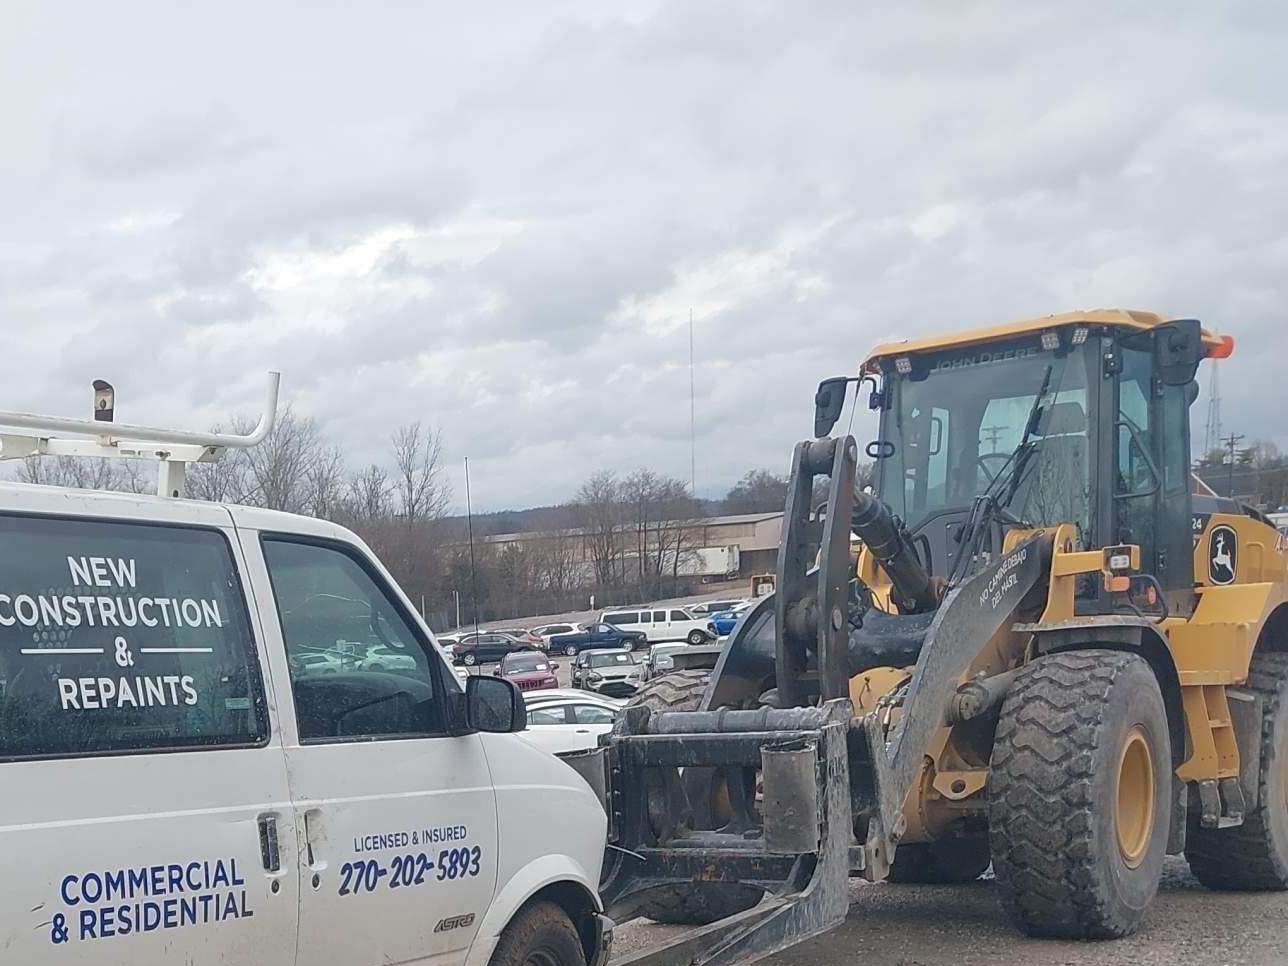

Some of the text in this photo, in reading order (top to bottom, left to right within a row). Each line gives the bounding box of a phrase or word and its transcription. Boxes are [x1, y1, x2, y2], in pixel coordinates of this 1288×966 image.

[67, 556, 136, 588] NEW
[114, 636, 134, 667] &
[58, 675, 198, 710] REPAINTS
[354, 825, 467, 852] LICENSED & INSURED
[61, 857, 244, 906] COMMERCIAL
[338, 845, 481, 896] 270-202-5893
[51, 890, 254, 944] & RESIDENTIAL
[433, 912, 476, 933] ASTRO
